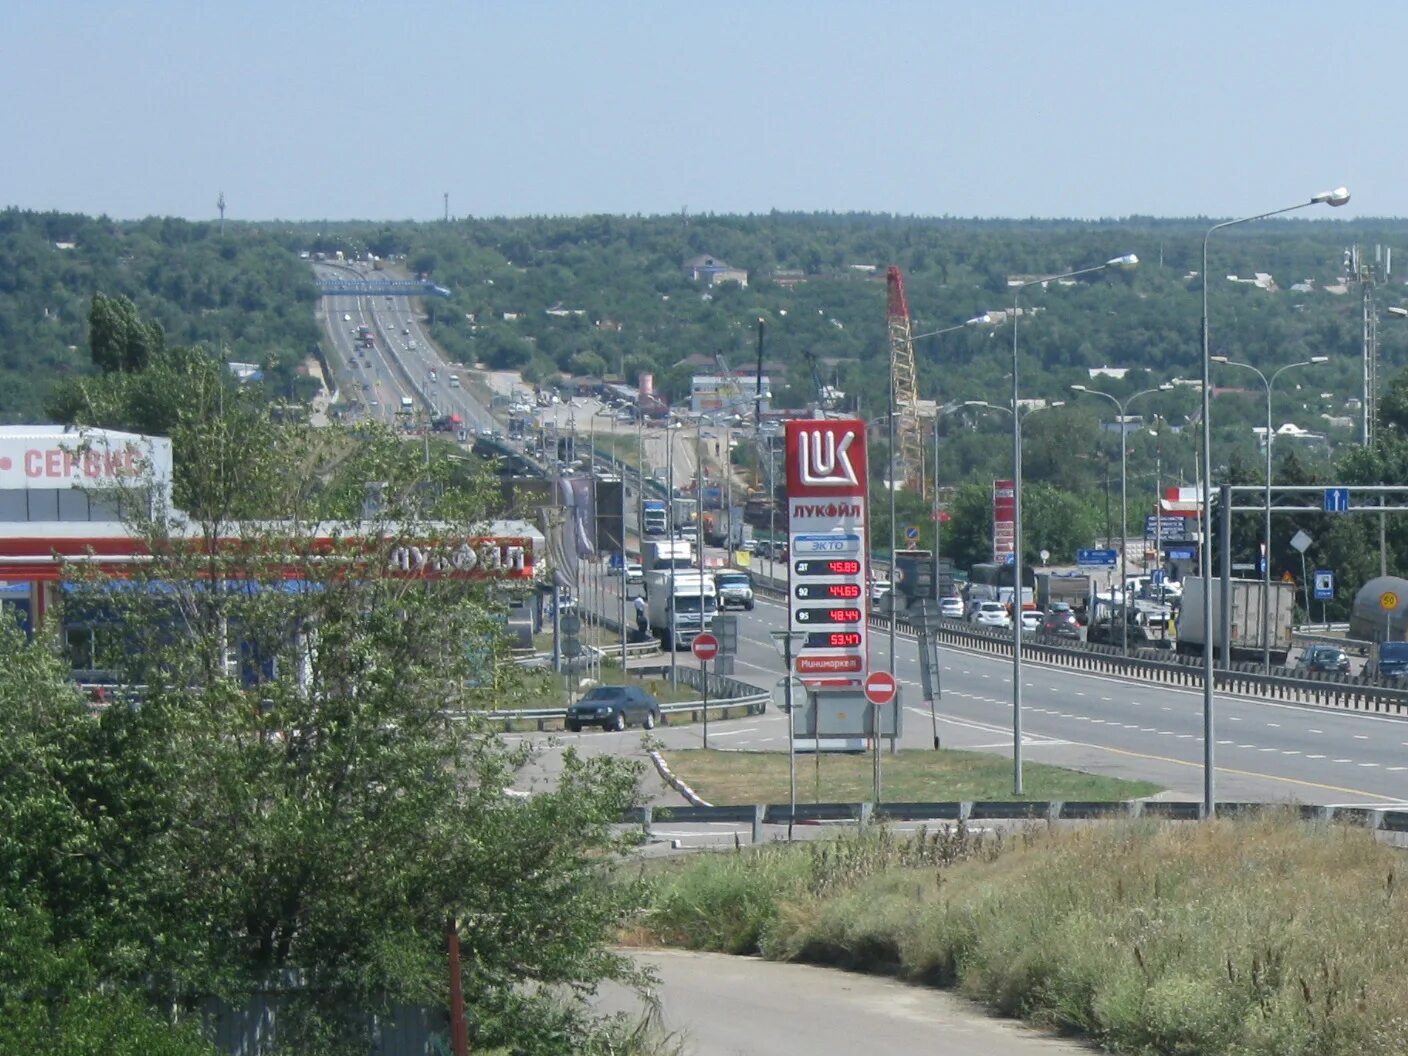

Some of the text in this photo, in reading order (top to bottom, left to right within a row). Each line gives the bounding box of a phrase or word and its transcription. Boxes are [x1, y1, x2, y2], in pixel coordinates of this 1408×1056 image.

[793, 503, 861, 518] ЛУКОЙЛ
[812, 541, 843, 550] ЭКТО
[829, 562, 858, 573] 45.89
[798, 586, 859, 597] 92 44.65
[1383, 595, 1395, 605] 50
[799, 610, 859, 621] 95 48.44
[831, 634, 859, 645] 53.47
